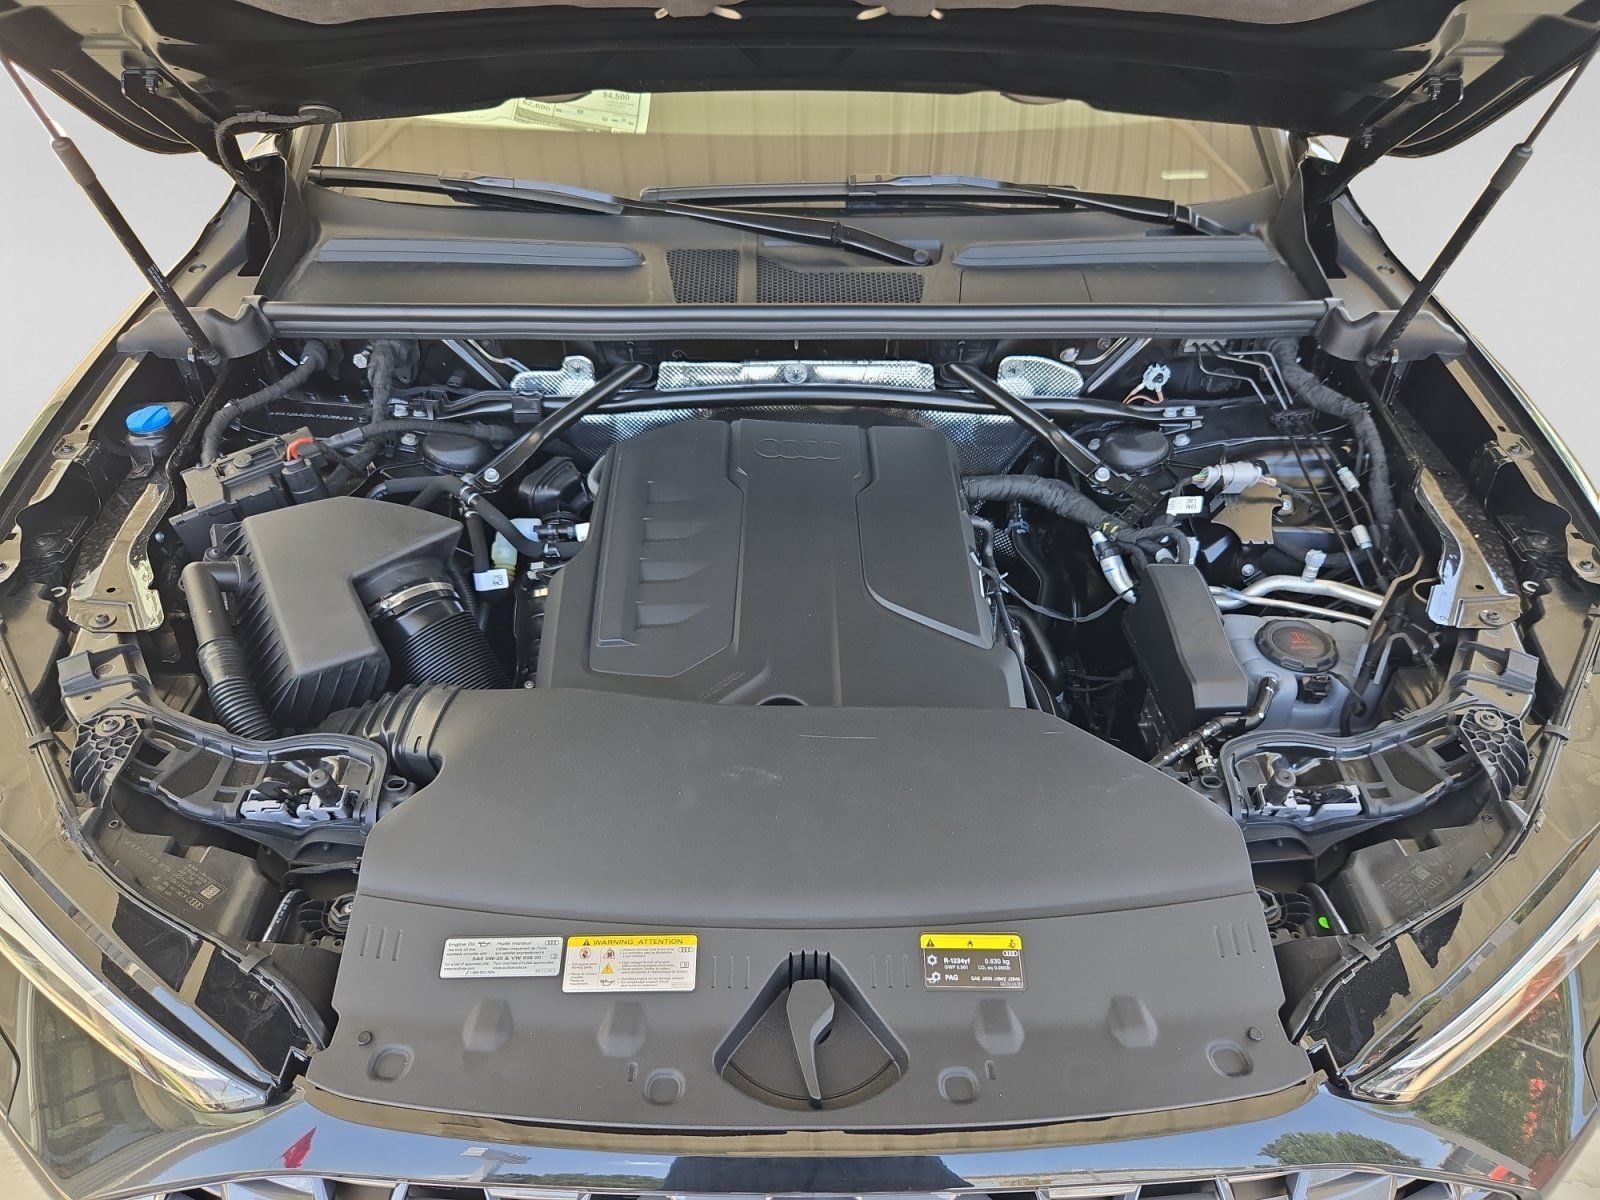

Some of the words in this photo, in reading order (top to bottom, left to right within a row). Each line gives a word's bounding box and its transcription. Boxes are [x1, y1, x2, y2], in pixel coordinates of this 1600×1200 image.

[602, 91, 630, 101] $4,500
[943, 957, 971, 965] R-1234yf
[1002, 958, 1011, 966] kg
